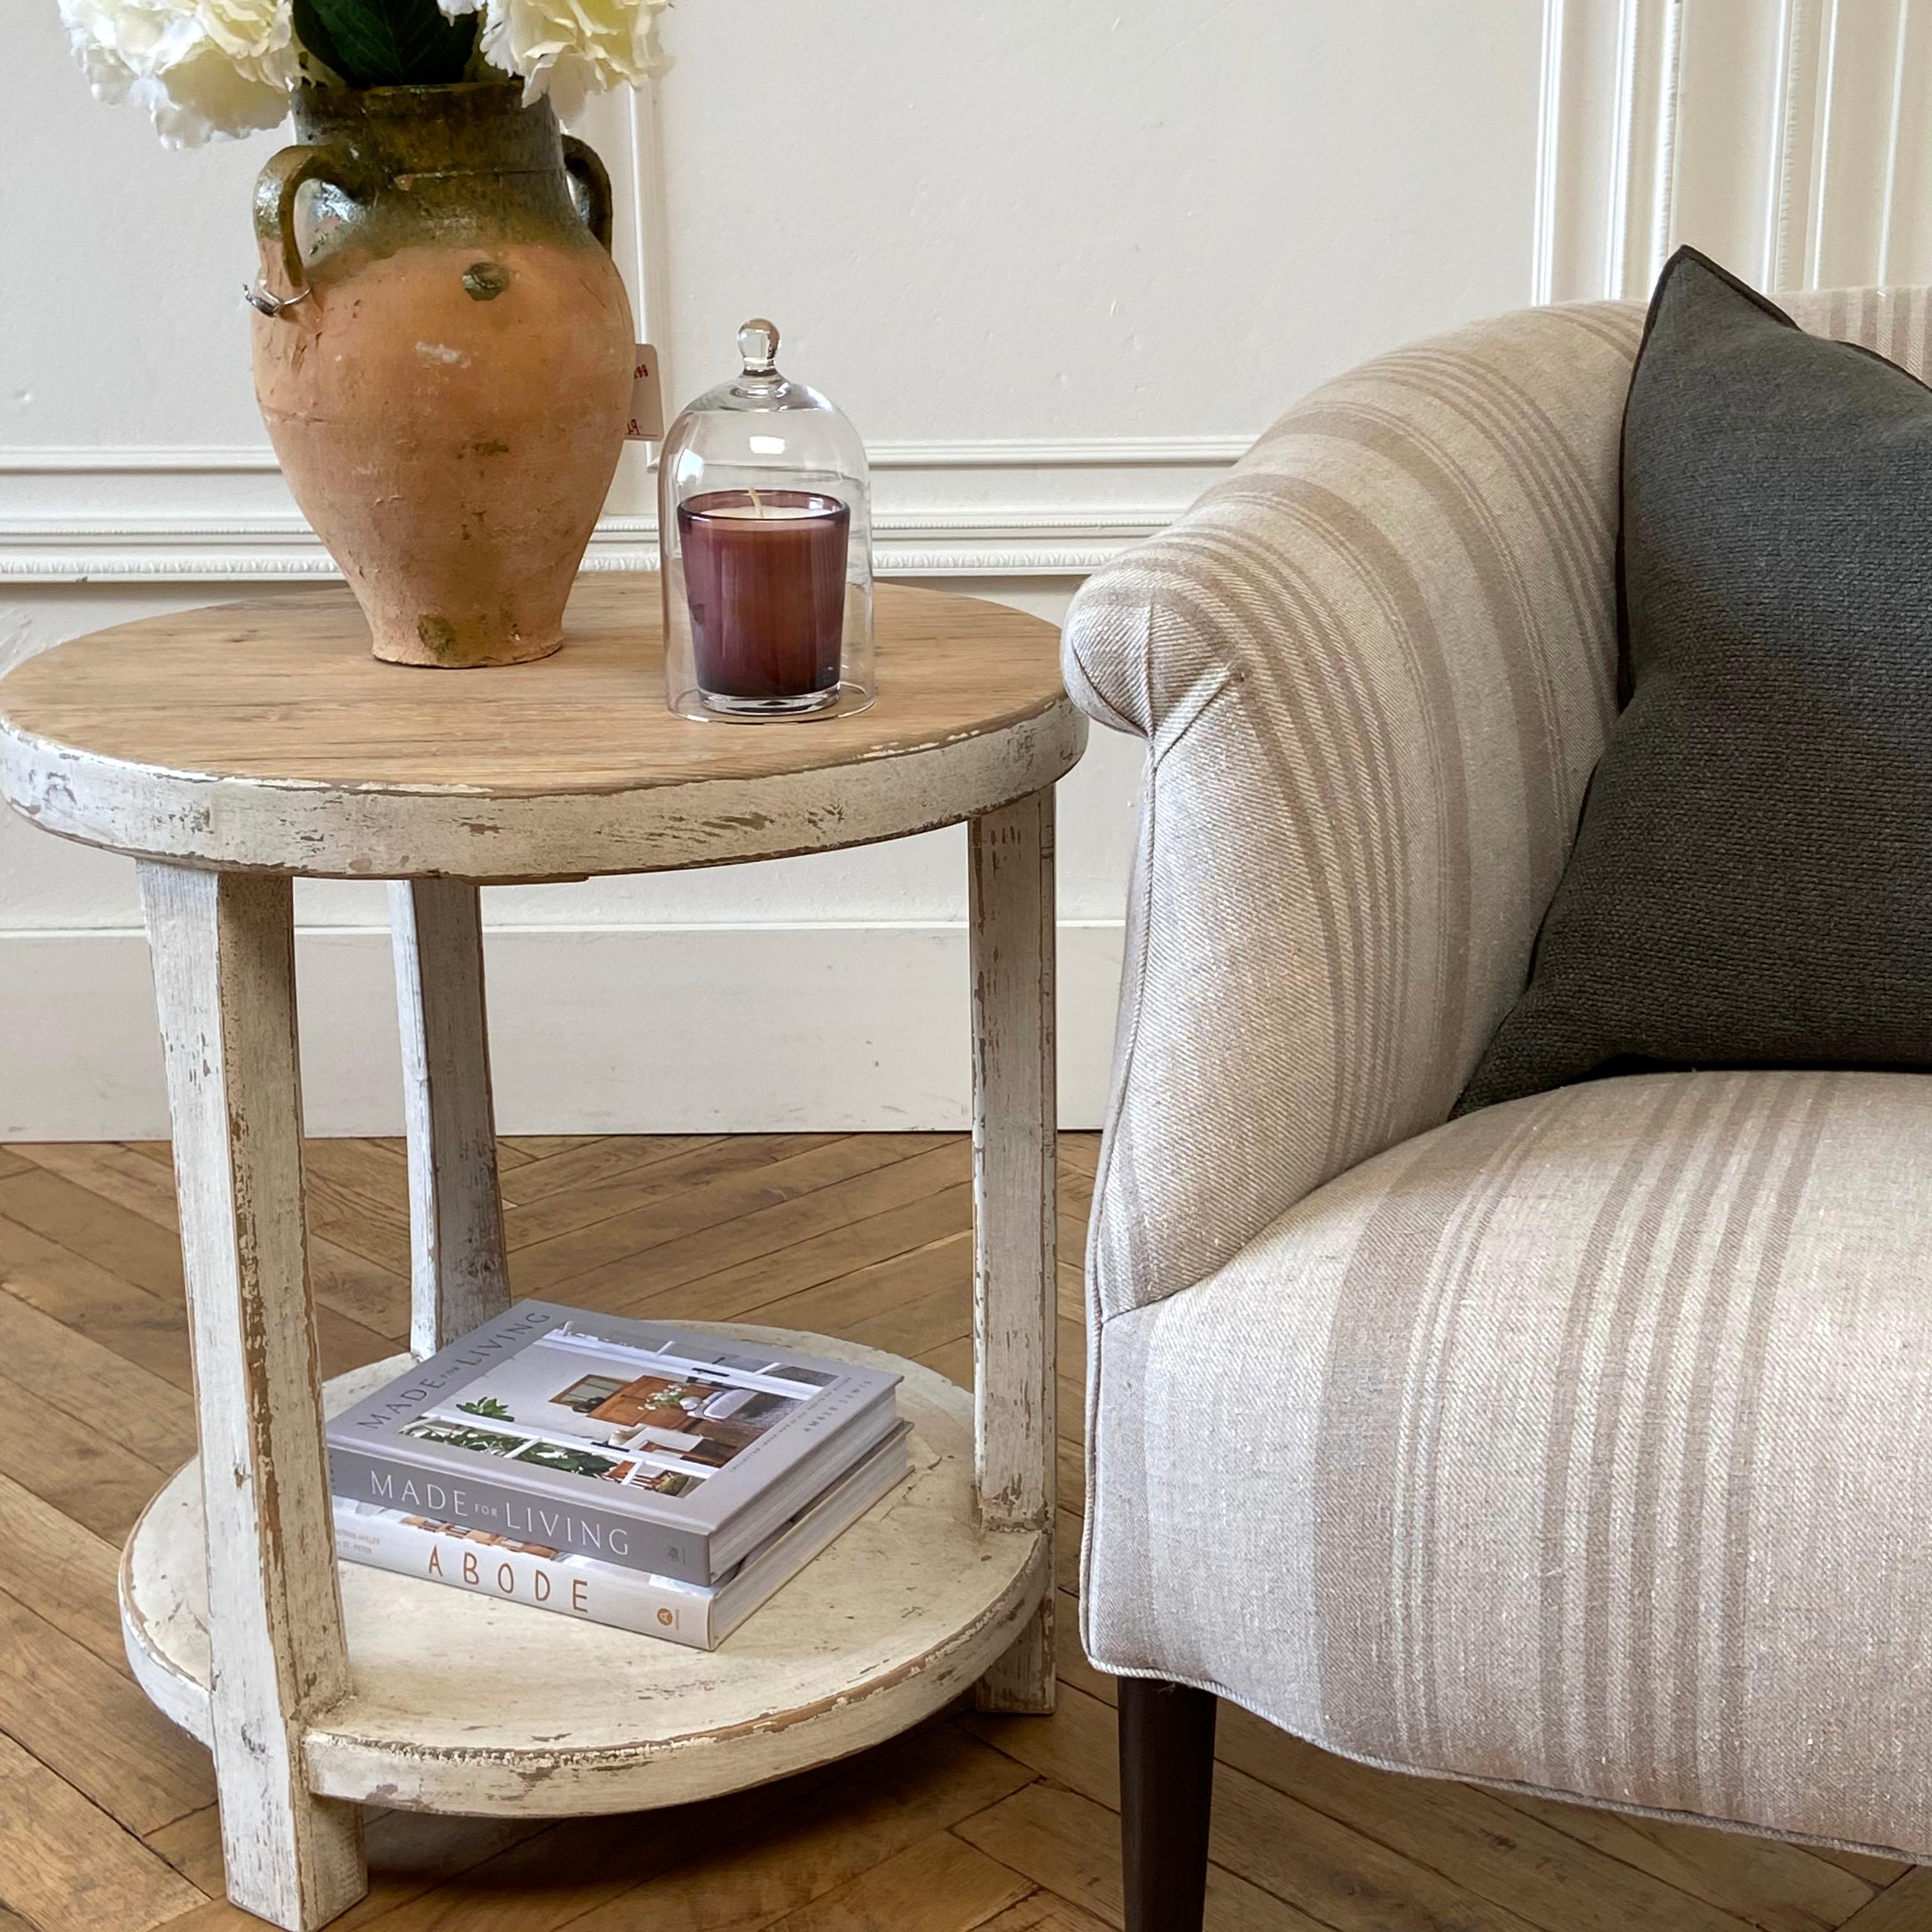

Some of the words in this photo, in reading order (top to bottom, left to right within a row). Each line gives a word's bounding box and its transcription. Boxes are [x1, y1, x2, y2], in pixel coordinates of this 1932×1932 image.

[357, 1378, 446, 1429] MADE
[456, 1312, 551, 1366] LIVING
[803, 1406, 838, 1432] AMBER
[370, 1470, 468, 1517] MADE
[475, 1503, 498, 1517] FOR
[505, 1502, 629, 1556] LIVING
[429, 1544, 588, 1613] ABODE
